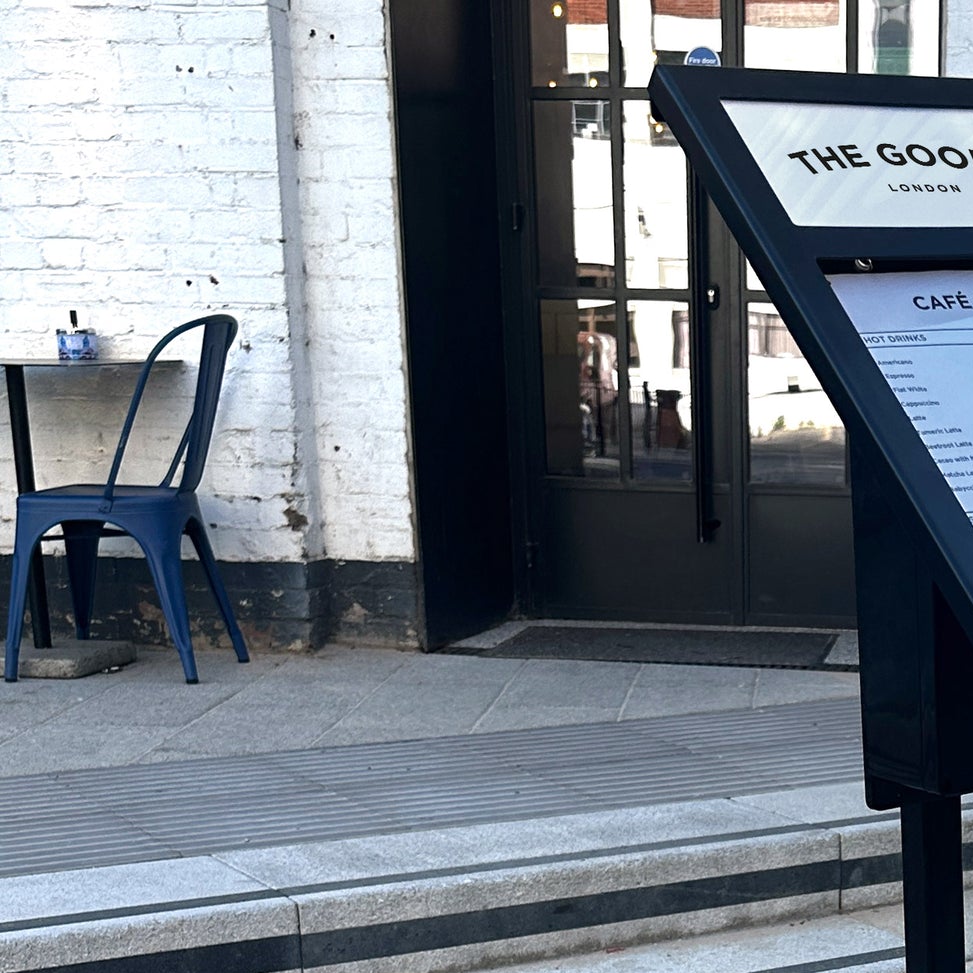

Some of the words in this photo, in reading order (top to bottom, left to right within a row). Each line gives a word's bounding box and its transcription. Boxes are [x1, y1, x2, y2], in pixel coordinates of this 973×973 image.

[788, 144, 871, 174] THE
[888, 184, 961, 192] LONDON
[913, 291, 973, 311] CAFÉ
[890, 334, 927, 342] DRINKS
